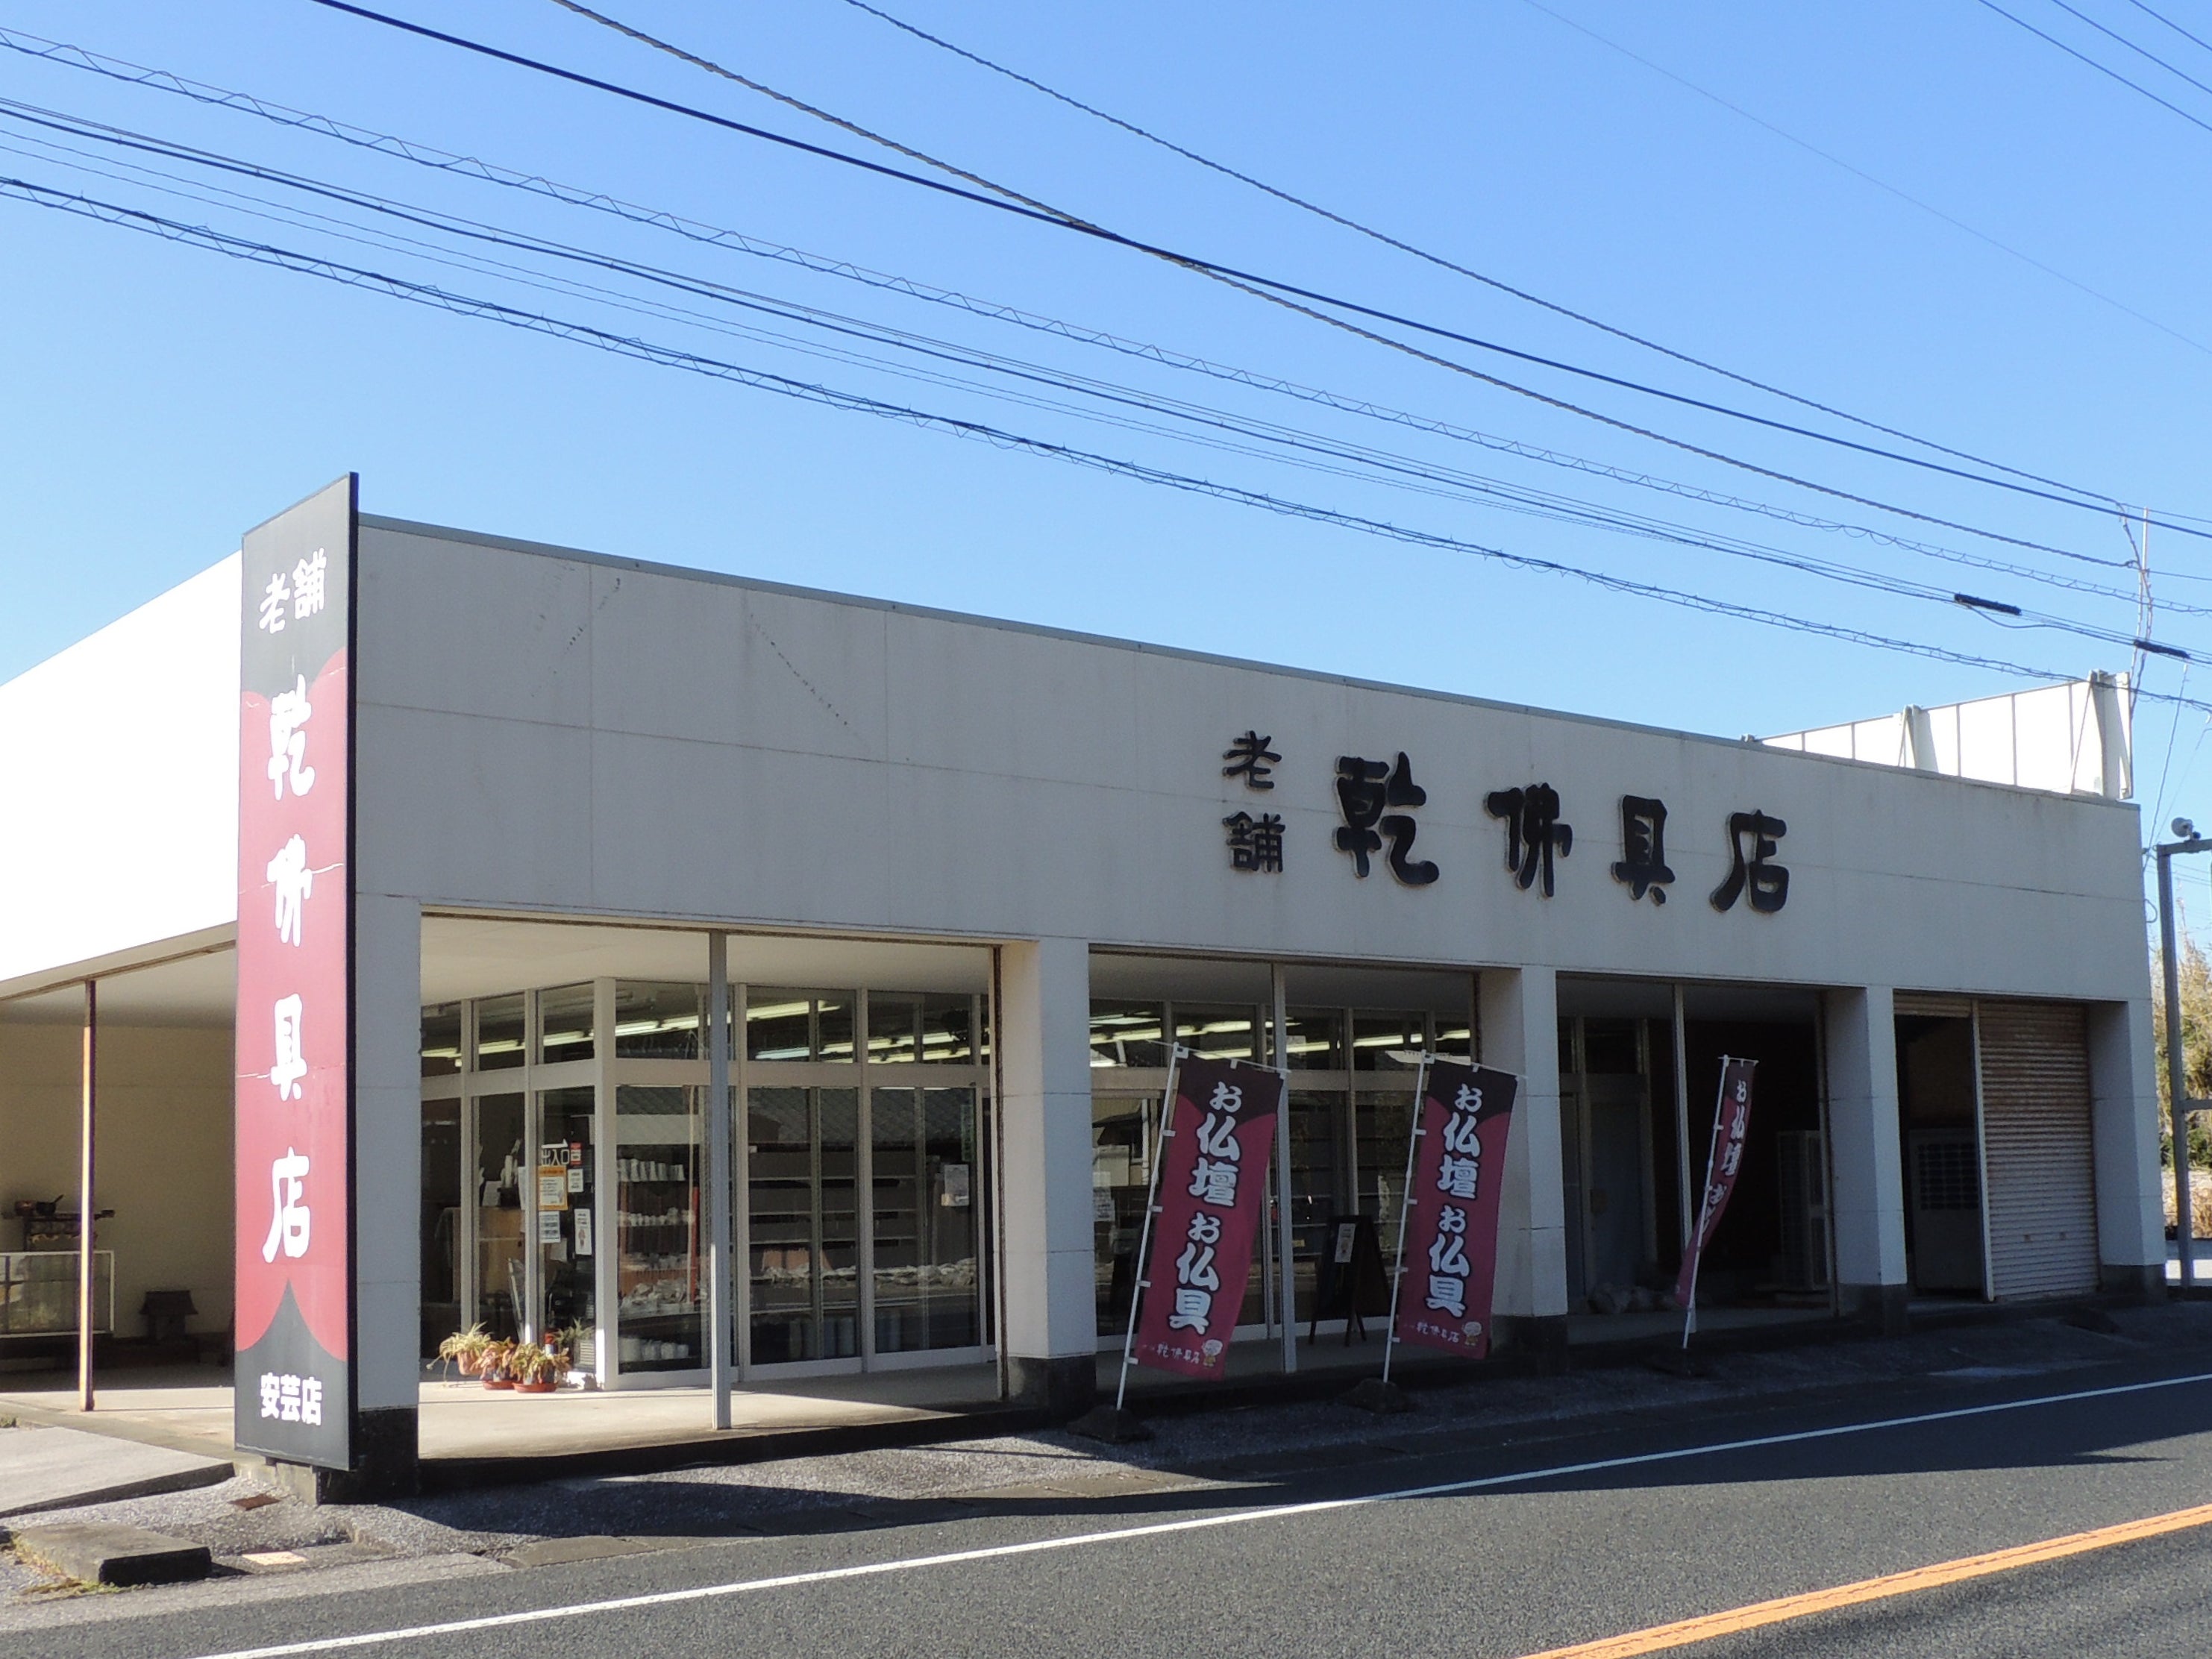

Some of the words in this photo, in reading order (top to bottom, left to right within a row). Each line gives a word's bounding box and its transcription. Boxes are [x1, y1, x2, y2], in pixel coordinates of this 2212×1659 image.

[259, 547, 327, 634] 老舗
[1222, 730, 1286, 874] 老舗
[1187, 1080, 1243, 1207] お仏壇
[1437, 1082, 1483, 1199] お仏壇
[1168, 1211, 1221, 1335] お仏具
[1425, 1205, 1470, 1318] お仏具
[260, 1372, 323, 1426] 安芸店
